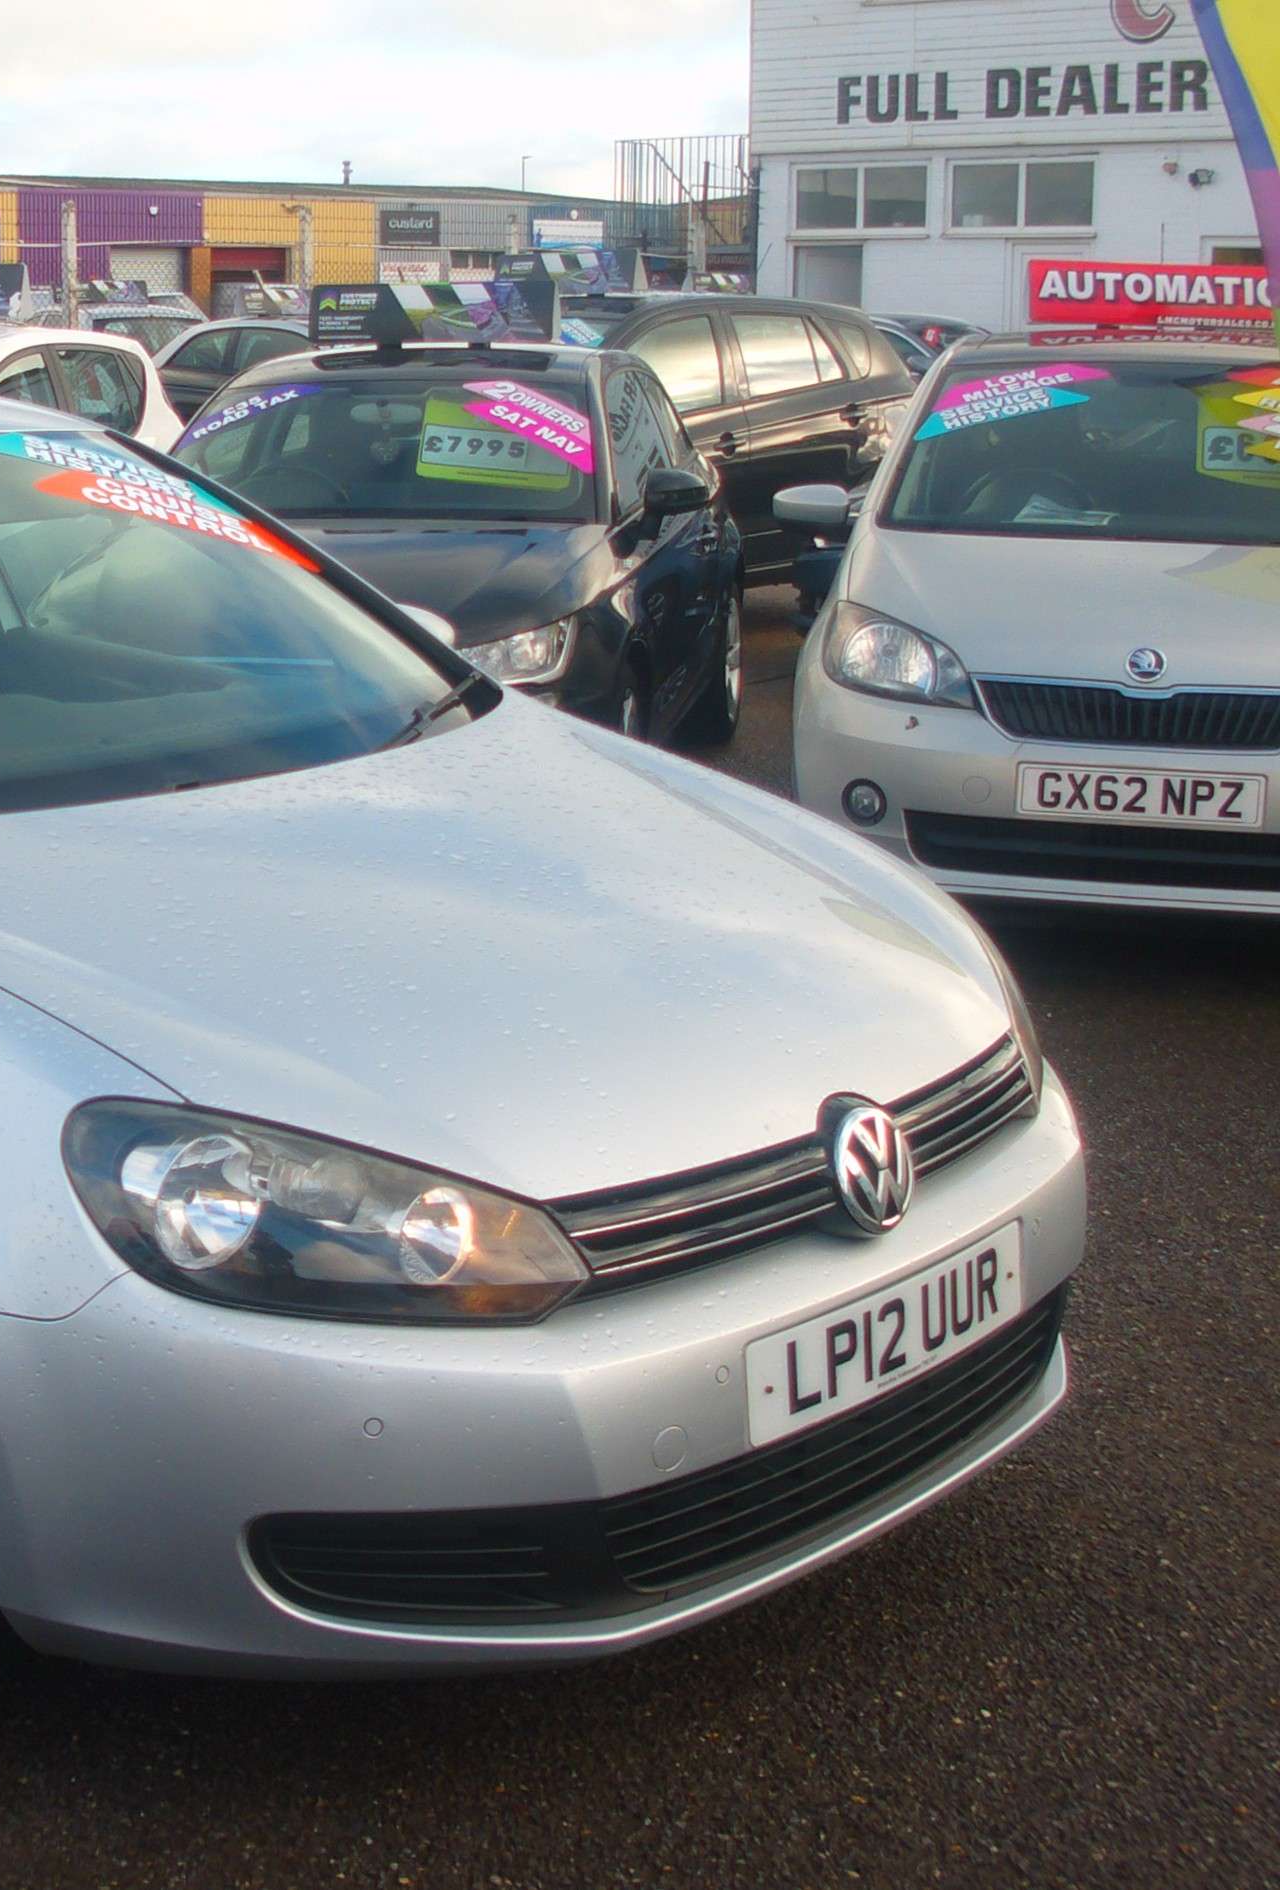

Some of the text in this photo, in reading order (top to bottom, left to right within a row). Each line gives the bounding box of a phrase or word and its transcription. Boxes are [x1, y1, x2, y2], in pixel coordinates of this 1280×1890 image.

[837, 60, 1208, 125] FULL DEALER
[388, 215, 433, 230] custard
[939, 388, 1047, 420] SERVICE
[962, 373, 1074, 402] MILEAGE
[984, 370, 1037, 388] LOW
[192, 389, 300, 439] ROAD TAX
[483, 381, 516, 400] 2
[512, 392, 586, 434] OWNERS
[489, 404, 584, 455] SAT NAV
[943, 397, 1053, 430] HISTORY
[21, 436, 190, 488] SERVICE
[424, 435, 527, 459] £7995
[24, 446, 197, 500] HISTORY
[80, 487, 274, 553] CONTROL
[95, 478, 242, 529] CRUISE
[1037, 772, 1245, 819] GX62 NPZ
[786, 1247, 999, 1416] LP12 UUR
